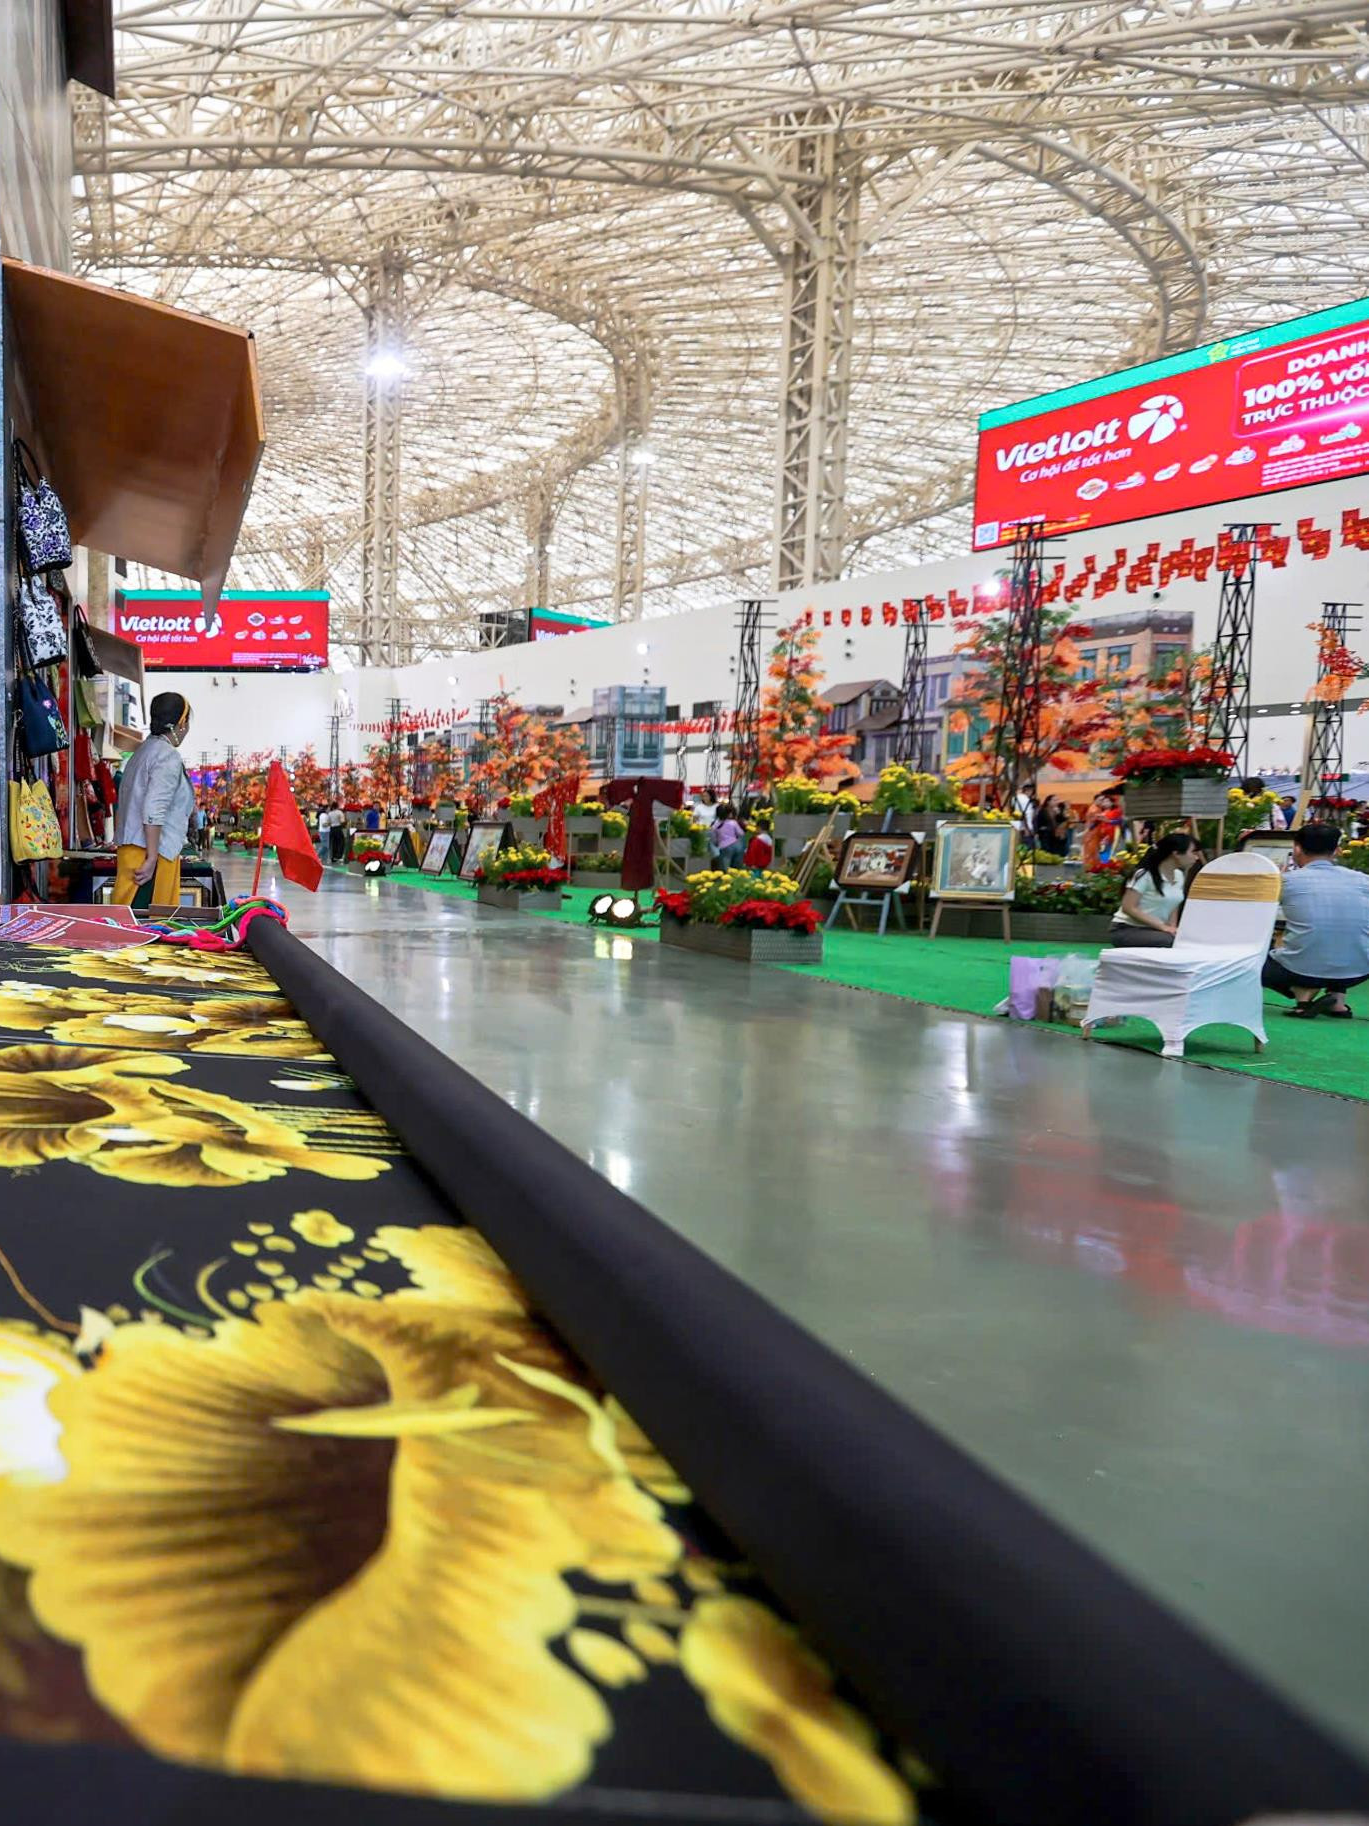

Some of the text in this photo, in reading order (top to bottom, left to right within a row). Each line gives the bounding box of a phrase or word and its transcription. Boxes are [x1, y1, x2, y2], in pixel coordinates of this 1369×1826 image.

[1286, 340, 1369, 374] DOANH
[1240, 384, 1369, 426] TRỰC THUỘC
[1242, 371, 1325, 408] 100%
[996, 418, 1122, 472] Vietlott
[1038, 463, 1061, 479] hội
[1062, 455, 1082, 473] để
[120, 615, 191, 631] Vietlott
